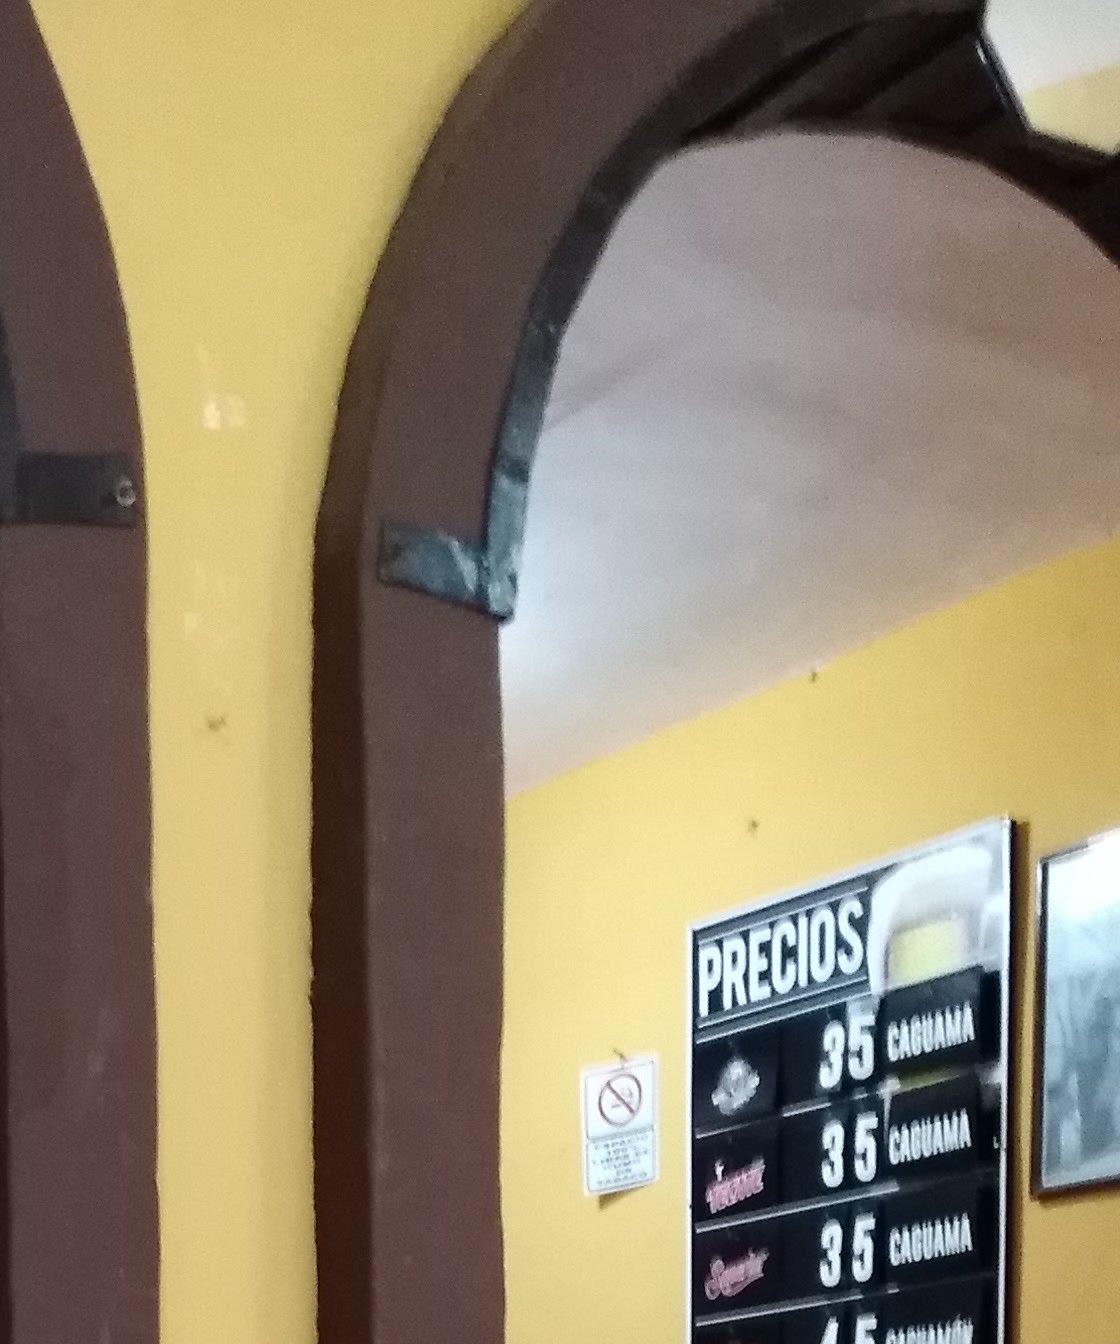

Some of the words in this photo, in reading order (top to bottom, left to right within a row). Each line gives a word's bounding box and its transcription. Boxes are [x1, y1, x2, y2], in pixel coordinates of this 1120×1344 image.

[698, 895, 864, 1018] PRECIOS
[819, 1011, 876, 1090] 35
[887, 998, 976, 1064] CAGUAMA
[821, 1110, 879, 1189] 35
[888, 1107, 972, 1166] CAGUAMA
[818, 1211, 876, 1288] 35
[888, 1211, 973, 1267] CAGUAMA
